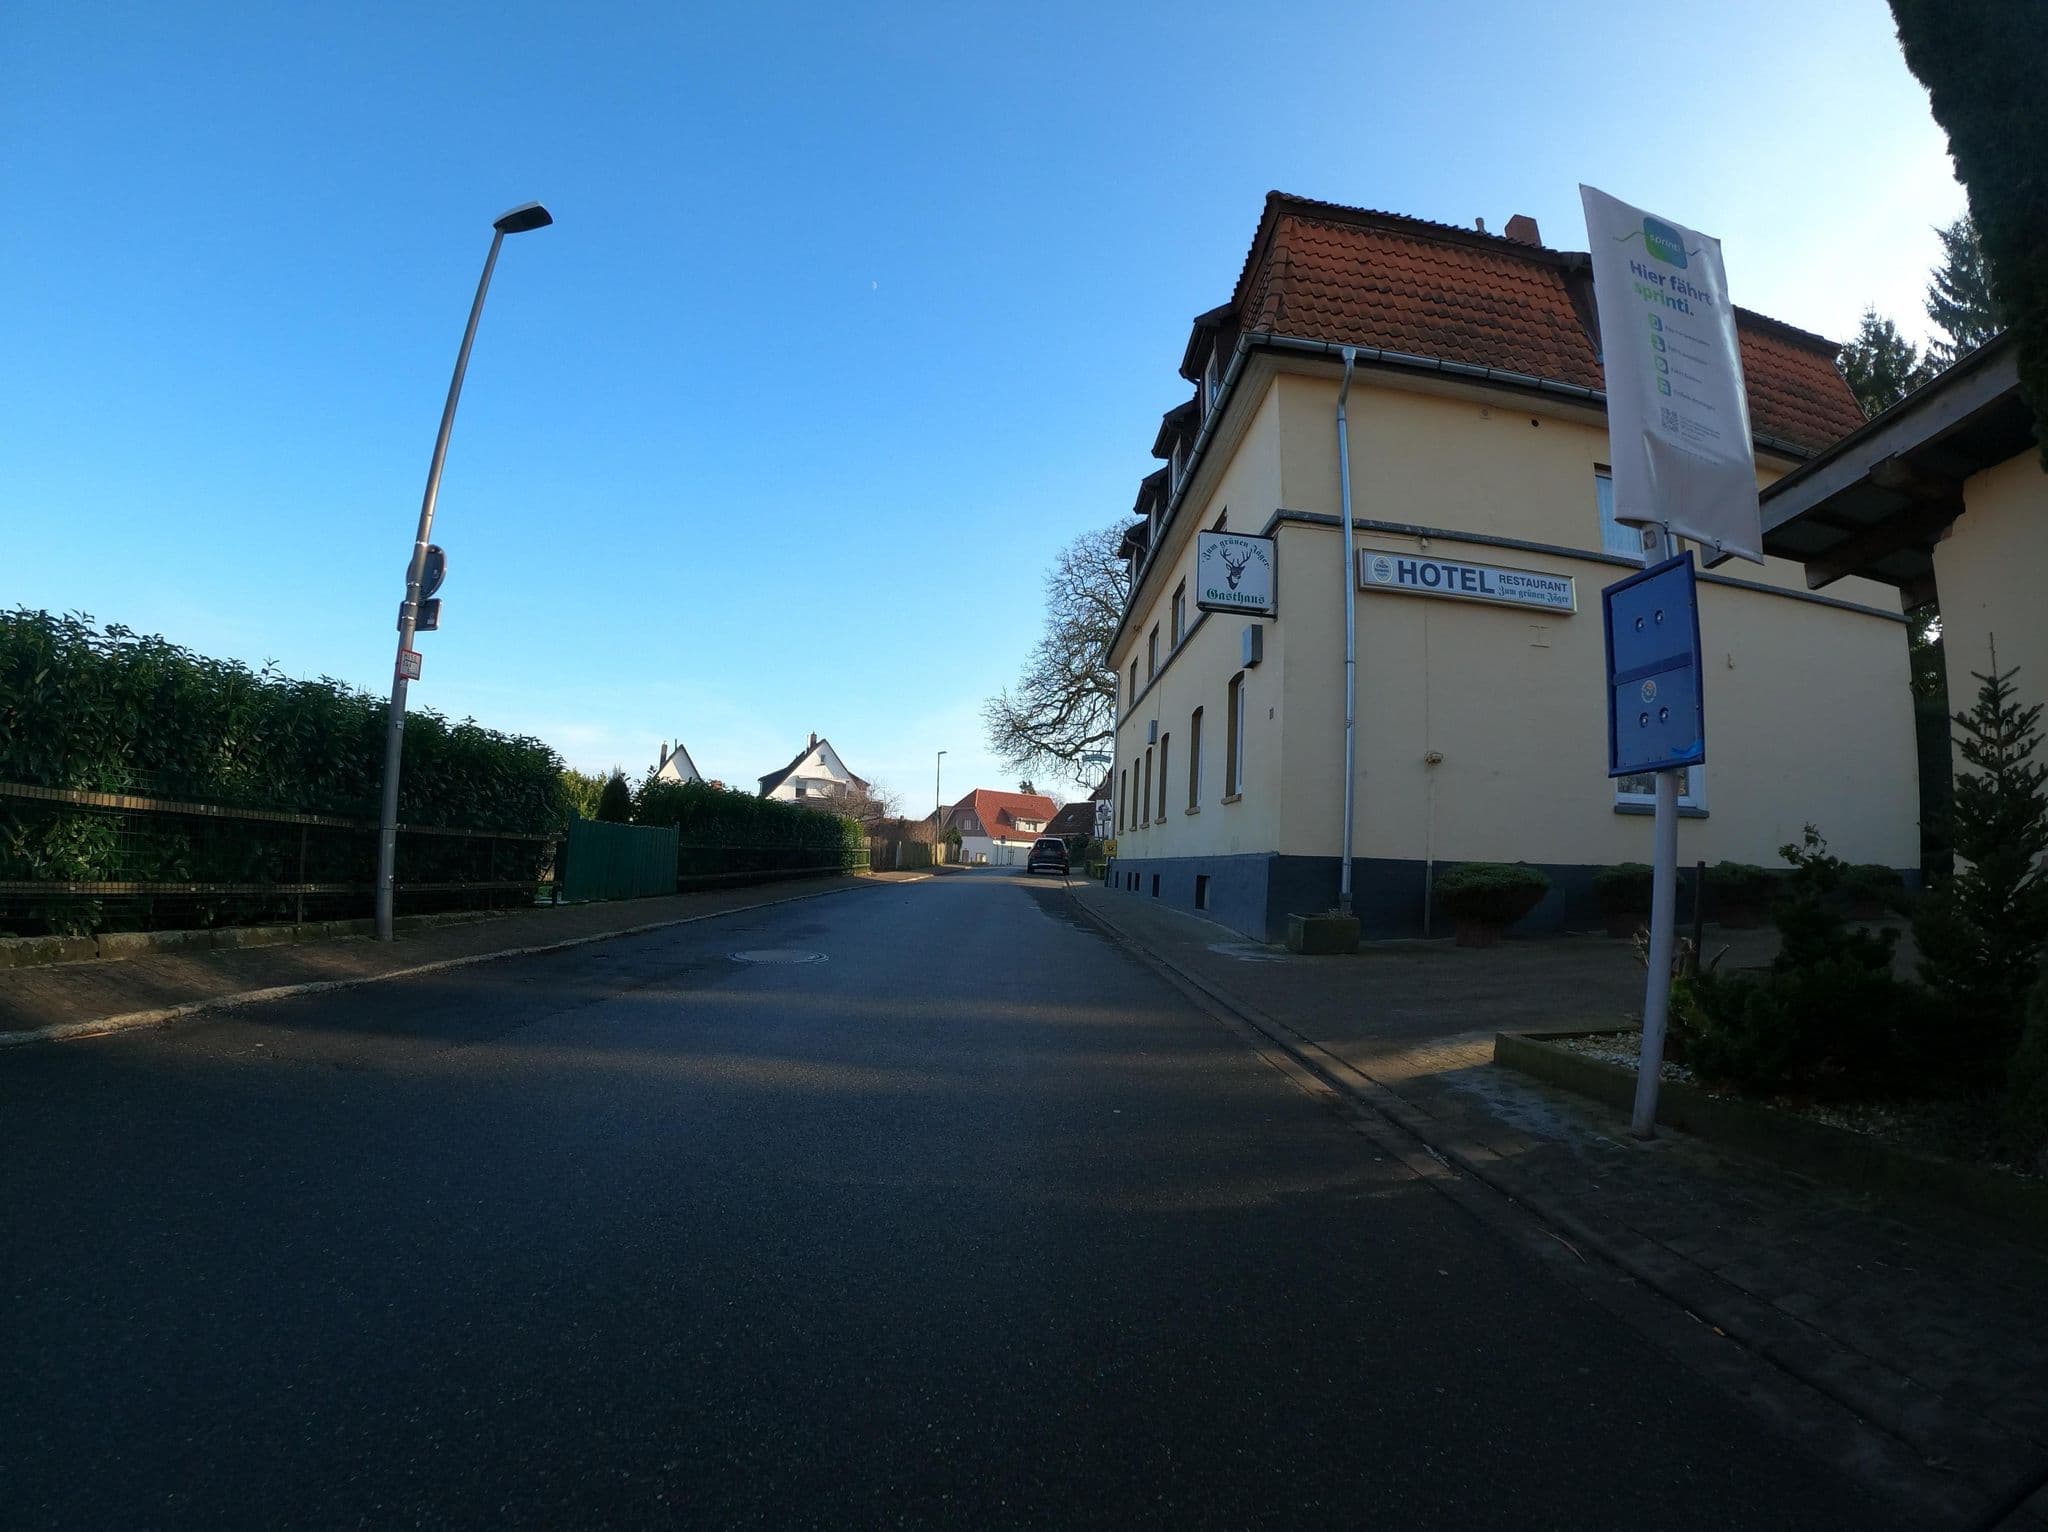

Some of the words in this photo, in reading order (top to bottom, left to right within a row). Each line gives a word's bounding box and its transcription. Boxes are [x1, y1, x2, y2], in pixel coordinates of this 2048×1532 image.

[1630, 259, 1666, 287] Hier
[1669, 275, 1713, 307] fährt
[1632, 280, 1695, 317] sprinti.
[1397, 560, 1495, 594] HOTEL
[1499, 574, 1568, 593] RESTAURANT
[1206, 588, 1265, 604] Gasthaus
